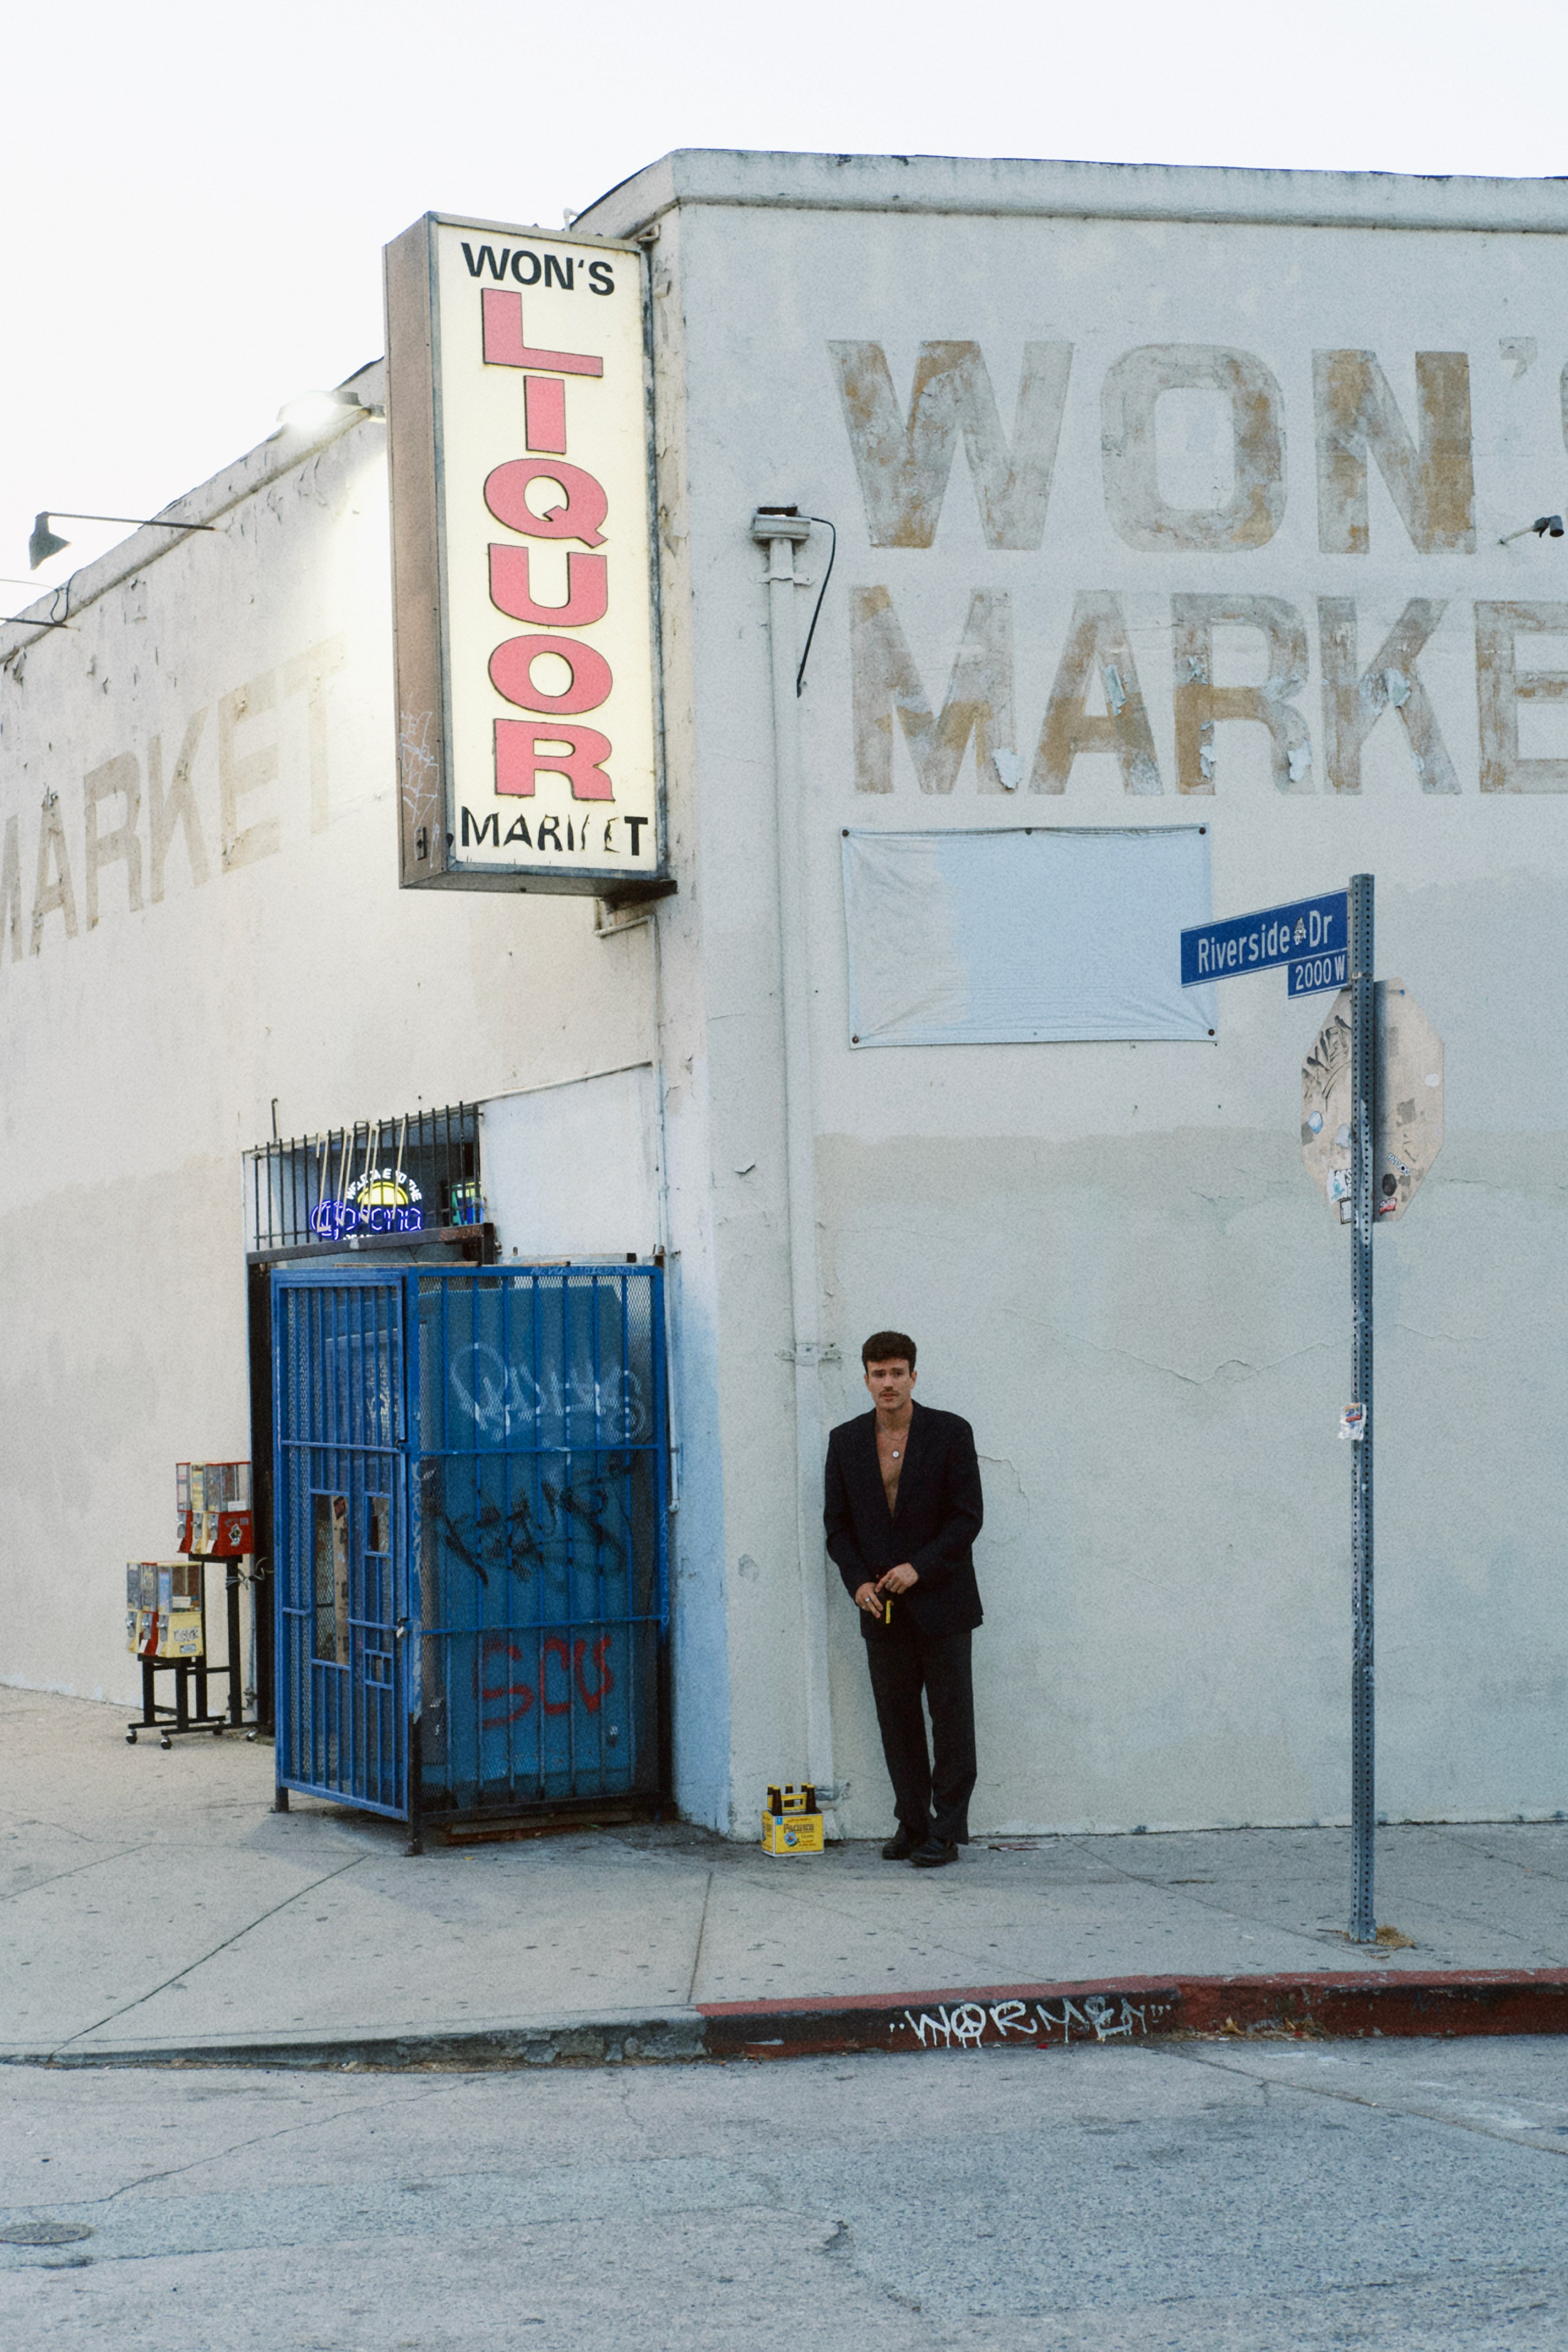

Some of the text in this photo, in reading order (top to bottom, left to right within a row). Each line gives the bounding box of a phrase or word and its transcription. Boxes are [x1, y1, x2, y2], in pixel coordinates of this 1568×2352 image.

[461, 242, 616, 296] WON'S
[827, 337, 1568, 555] WON'
[481, 287, 616, 802] LIQUOR
[1197, 910, 1333, 973] Riverside Dr
[1295, 954, 1346, 991] 2000 W
